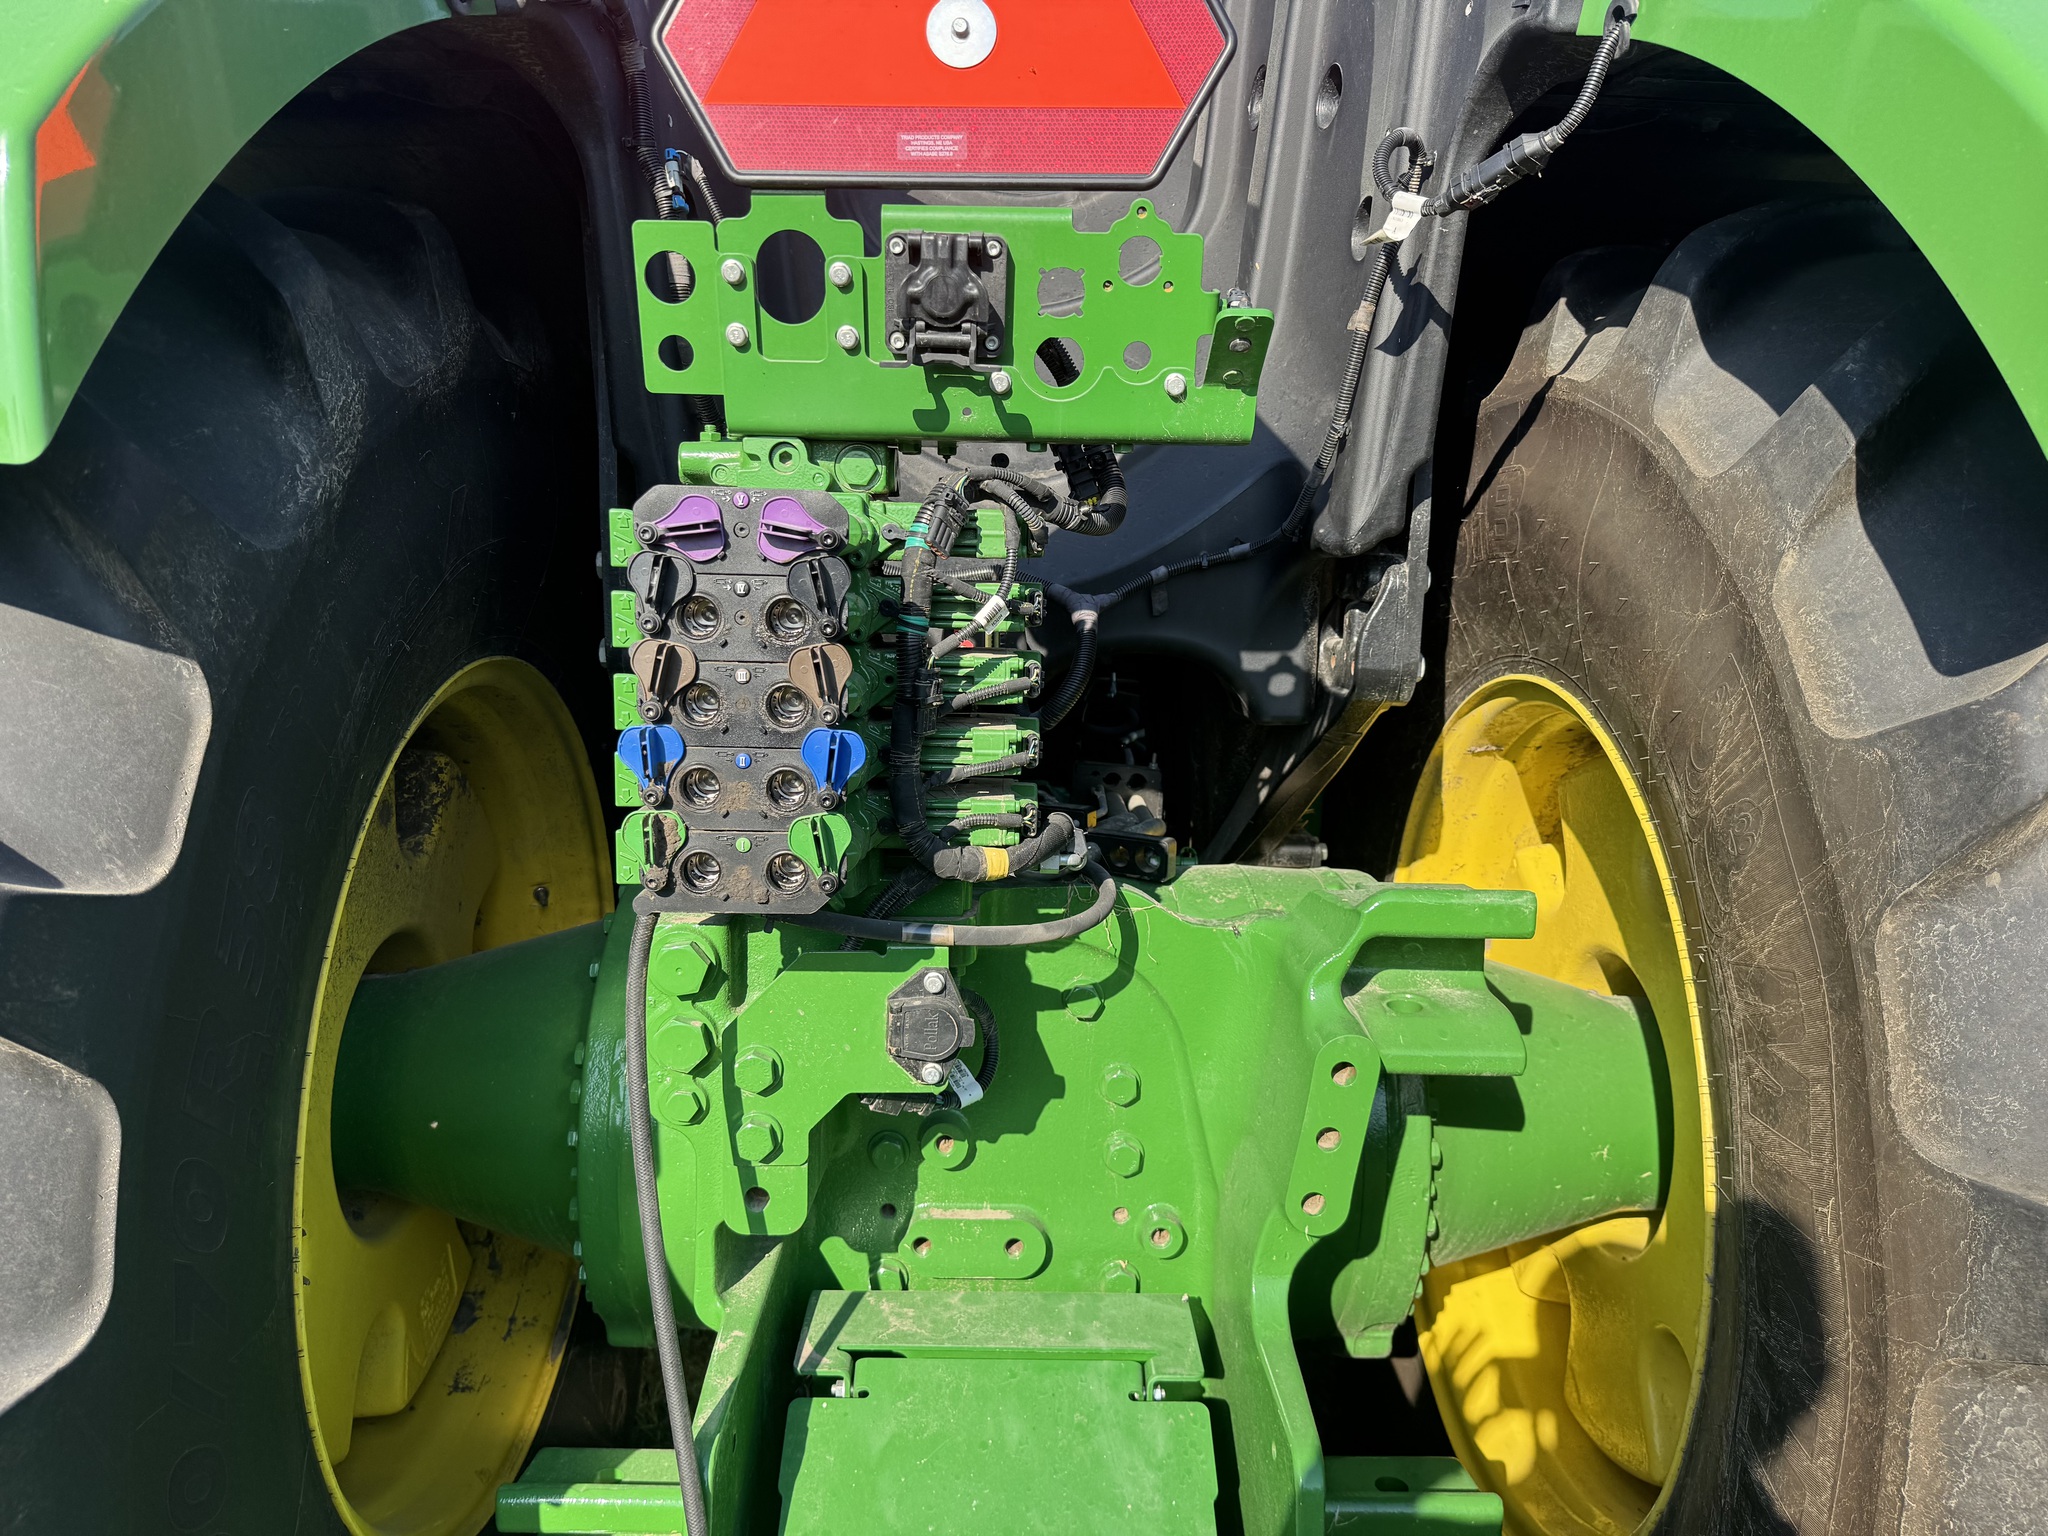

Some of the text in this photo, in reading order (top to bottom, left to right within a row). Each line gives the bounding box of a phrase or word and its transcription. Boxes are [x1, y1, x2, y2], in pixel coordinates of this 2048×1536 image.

[736, 494, 746, 507] V
[737, 583, 746, 594] IV
[737, 671, 747, 682] III
[739, 756, 746, 767] II
[923, 1012, 940, 1052] Pollak
